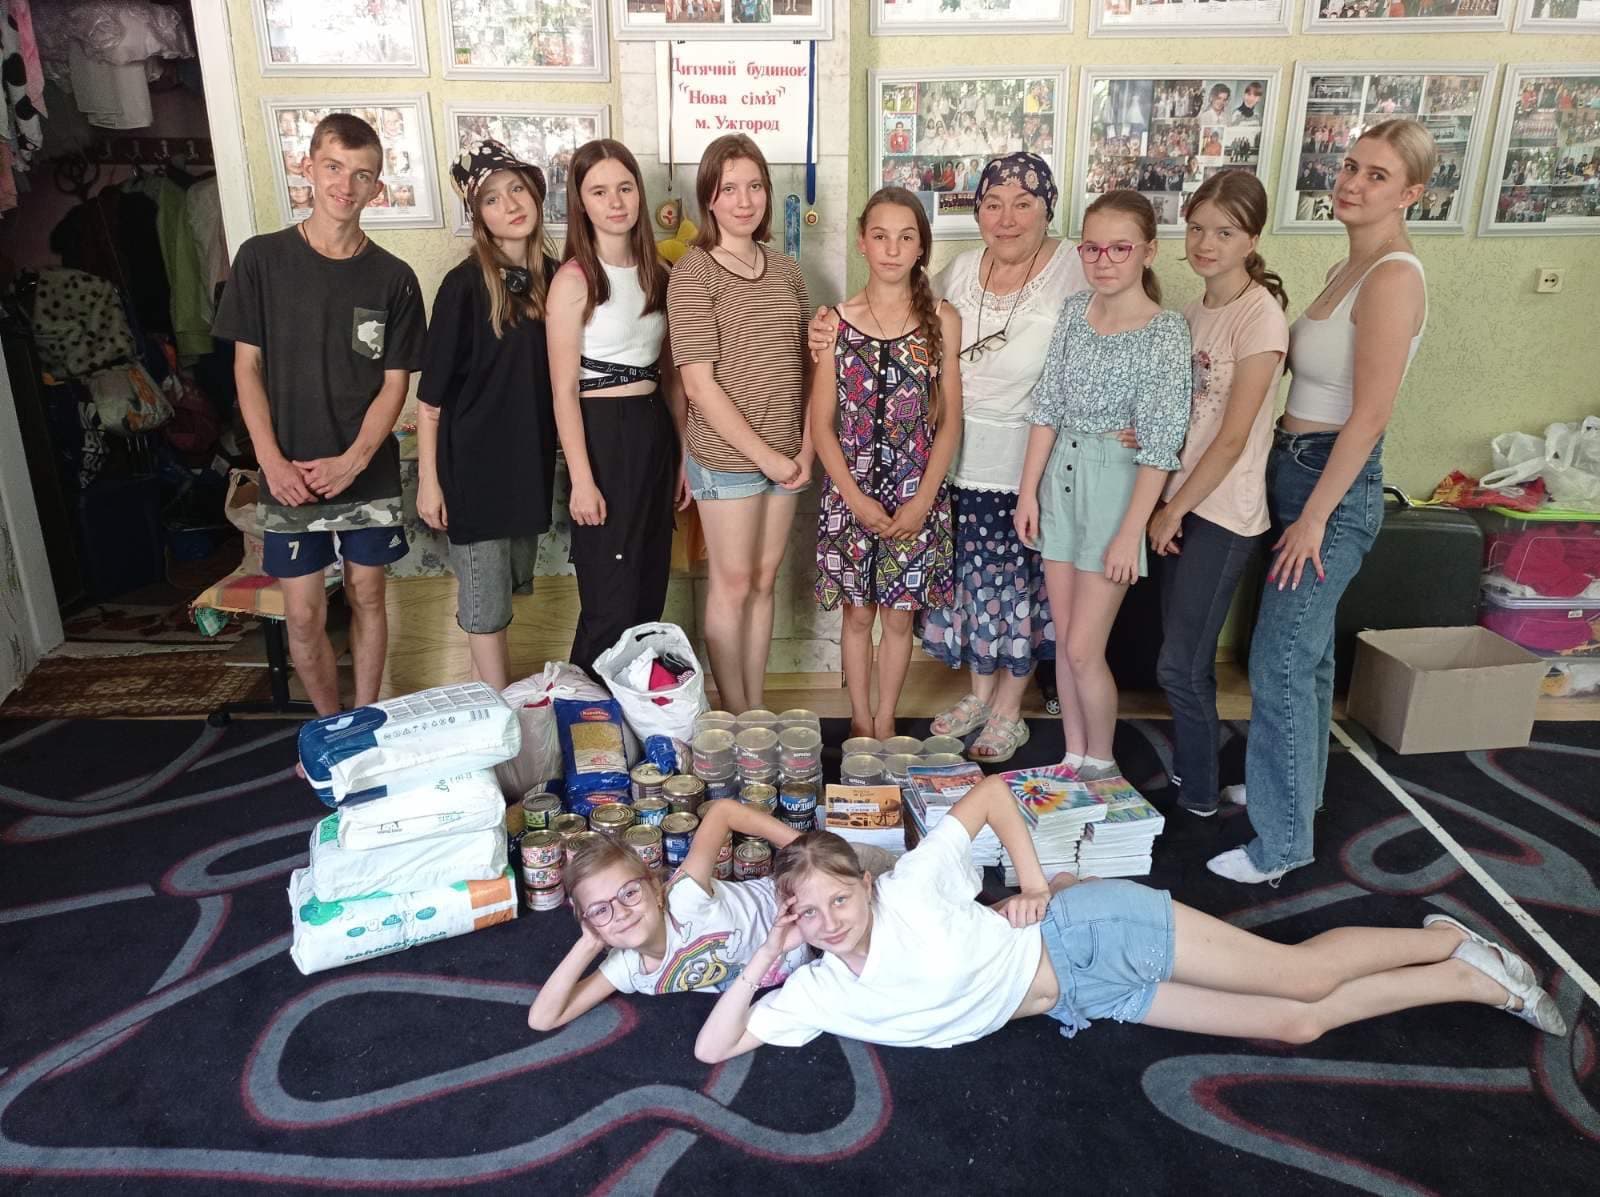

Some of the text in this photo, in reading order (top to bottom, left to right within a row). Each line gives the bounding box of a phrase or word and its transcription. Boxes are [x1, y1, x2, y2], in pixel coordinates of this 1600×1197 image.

[746, 62, 807, 79] будинок
[695, 115, 780, 134] м. Ужгород
[288, 540, 300, 560] 7
